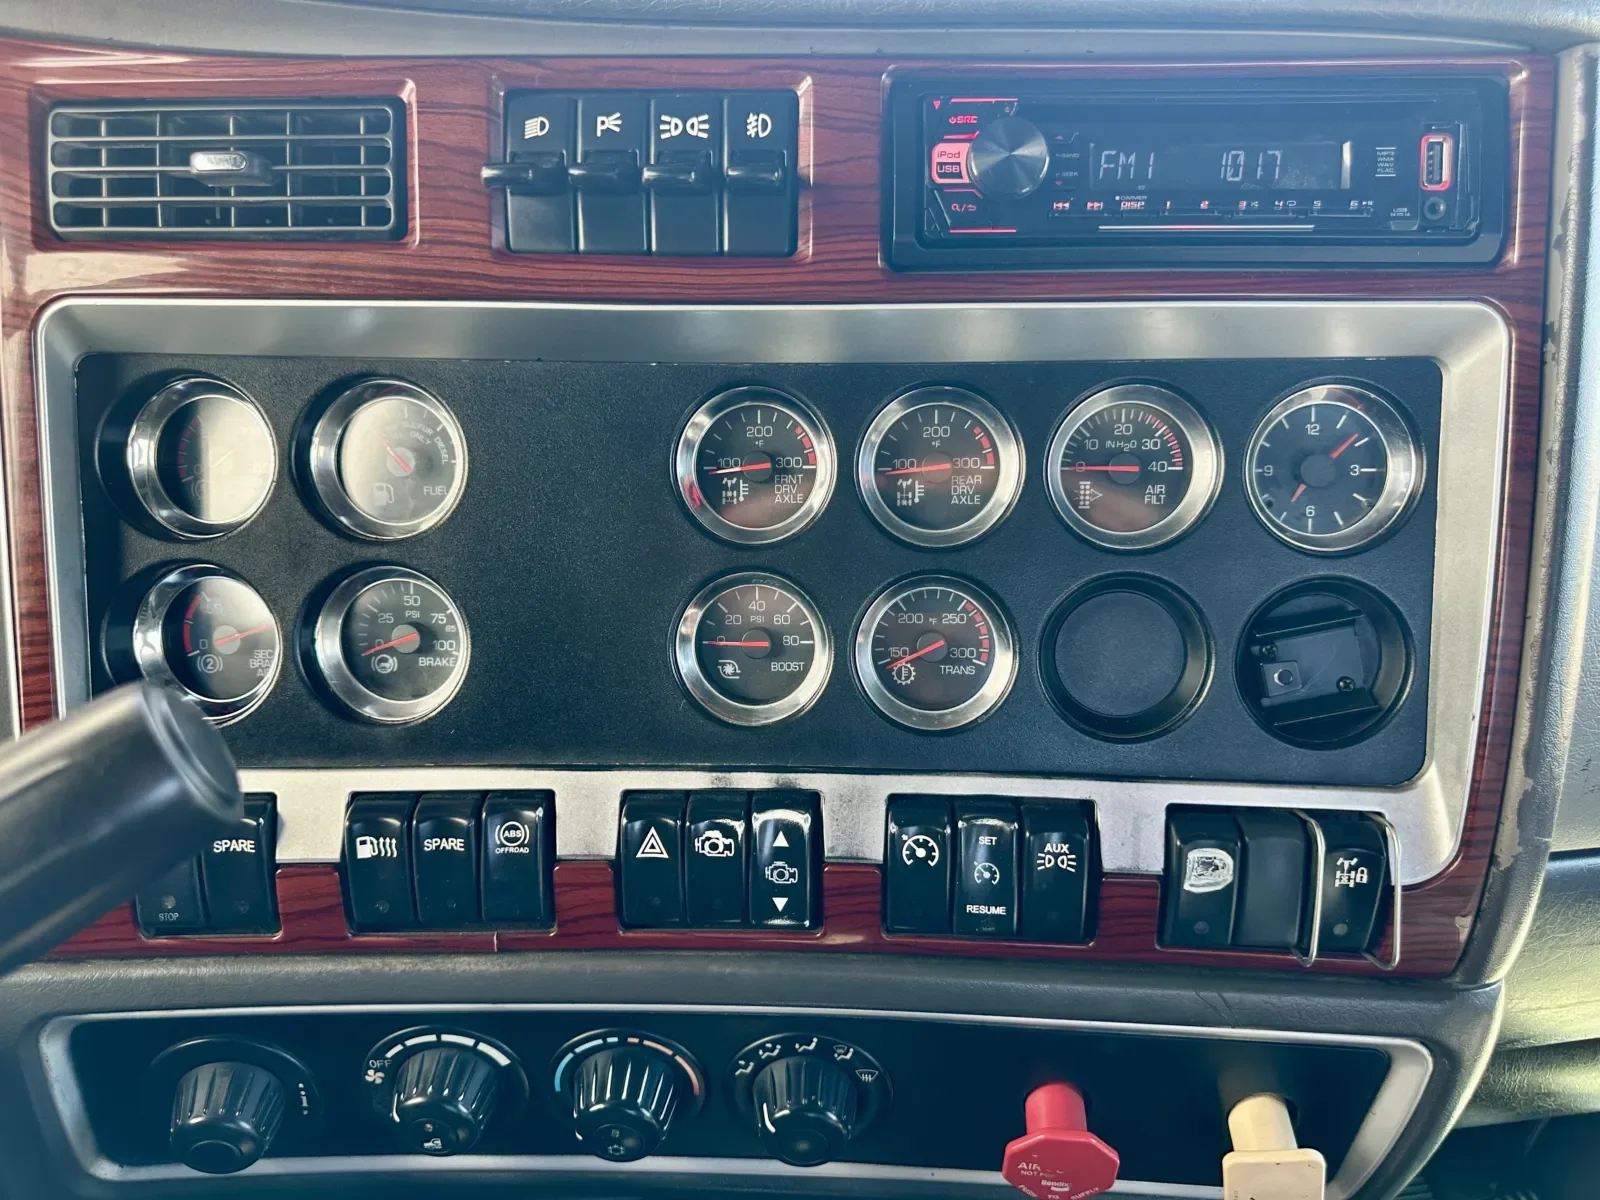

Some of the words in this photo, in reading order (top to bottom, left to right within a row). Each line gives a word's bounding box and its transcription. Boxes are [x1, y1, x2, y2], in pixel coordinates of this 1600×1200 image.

[937, 151, 960, 159] iPod
[937, 165, 960, 173] USB
[1120, 201, 1145, 209] DISP
[746, 426, 773, 437] 200
[922, 426, 950, 438] 200
[1113, 424, 1133, 435] 20
[1305, 424, 1320, 435] 12
[1084, 439, 1099, 450] 10
[1141, 439, 1161, 450] 30
[434, 436, 449, 465] DIESEL
[717, 457, 741, 468] 100
[775, 457, 803, 468] 300
[892, 459, 917, 469] 100
[952, 457, 980, 469] 300
[1148, 461, 1168, 473] 40
[1263, 465, 1273, 476] 9
[1350, 464, 1360, 476] 3
[774, 475, 804, 484] FRNT
[951, 476, 982, 485] REAR
[423, 486, 448, 496] FUEL
[774, 485, 798, 494] DRV
[951, 485, 975, 495] DRV
[1145, 485, 1166, 494] AIR
[774, 494, 804, 504] AXLE
[950, 495, 981, 505] AXLE
[1144, 495, 1166, 504] FILT
[1305, 505, 1315, 517] 6
[403, 595, 421, 606] 50
[748, 601, 766, 611] 40
[377, 613, 394, 624] 25
[405, 610, 420, 618] PSI
[430, 613, 447, 624] 75
[750, 615, 765, 623] PSI
[897, 613, 924, 624] 200
[942, 613, 967, 624] 250
[725, 614, 742, 625] 20
[773, 614, 791, 625] 60
[200, 639, 208, 649] 0
[433, 640, 456, 651] 100
[783, 635, 800, 646] 80
[253, 650, 274, 659] SEC
[888, 647, 909, 657] 150
[949, 648, 976, 658] 300
[418, 657, 457, 667] BRAKE
[771, 662, 805, 672] BOOST
[939, 665, 976, 675] TRANS
[503, 829, 523, 838] ABS
[212, 839, 256, 853] SPARE
[423, 838, 465, 851] SPARE
[978, 836, 998, 846] SET
[495, 846, 530, 854] OFFROAD
[1043, 843, 1070, 854] AUX
[966, 904, 1007, 915] RESUME
[158, 912, 180, 921] STOP
[369, 1059, 393, 1069] OFF
[1041, 1179, 1069, 1188] Bendix
[1070, 1186, 1100, 1200] SUPPLY
